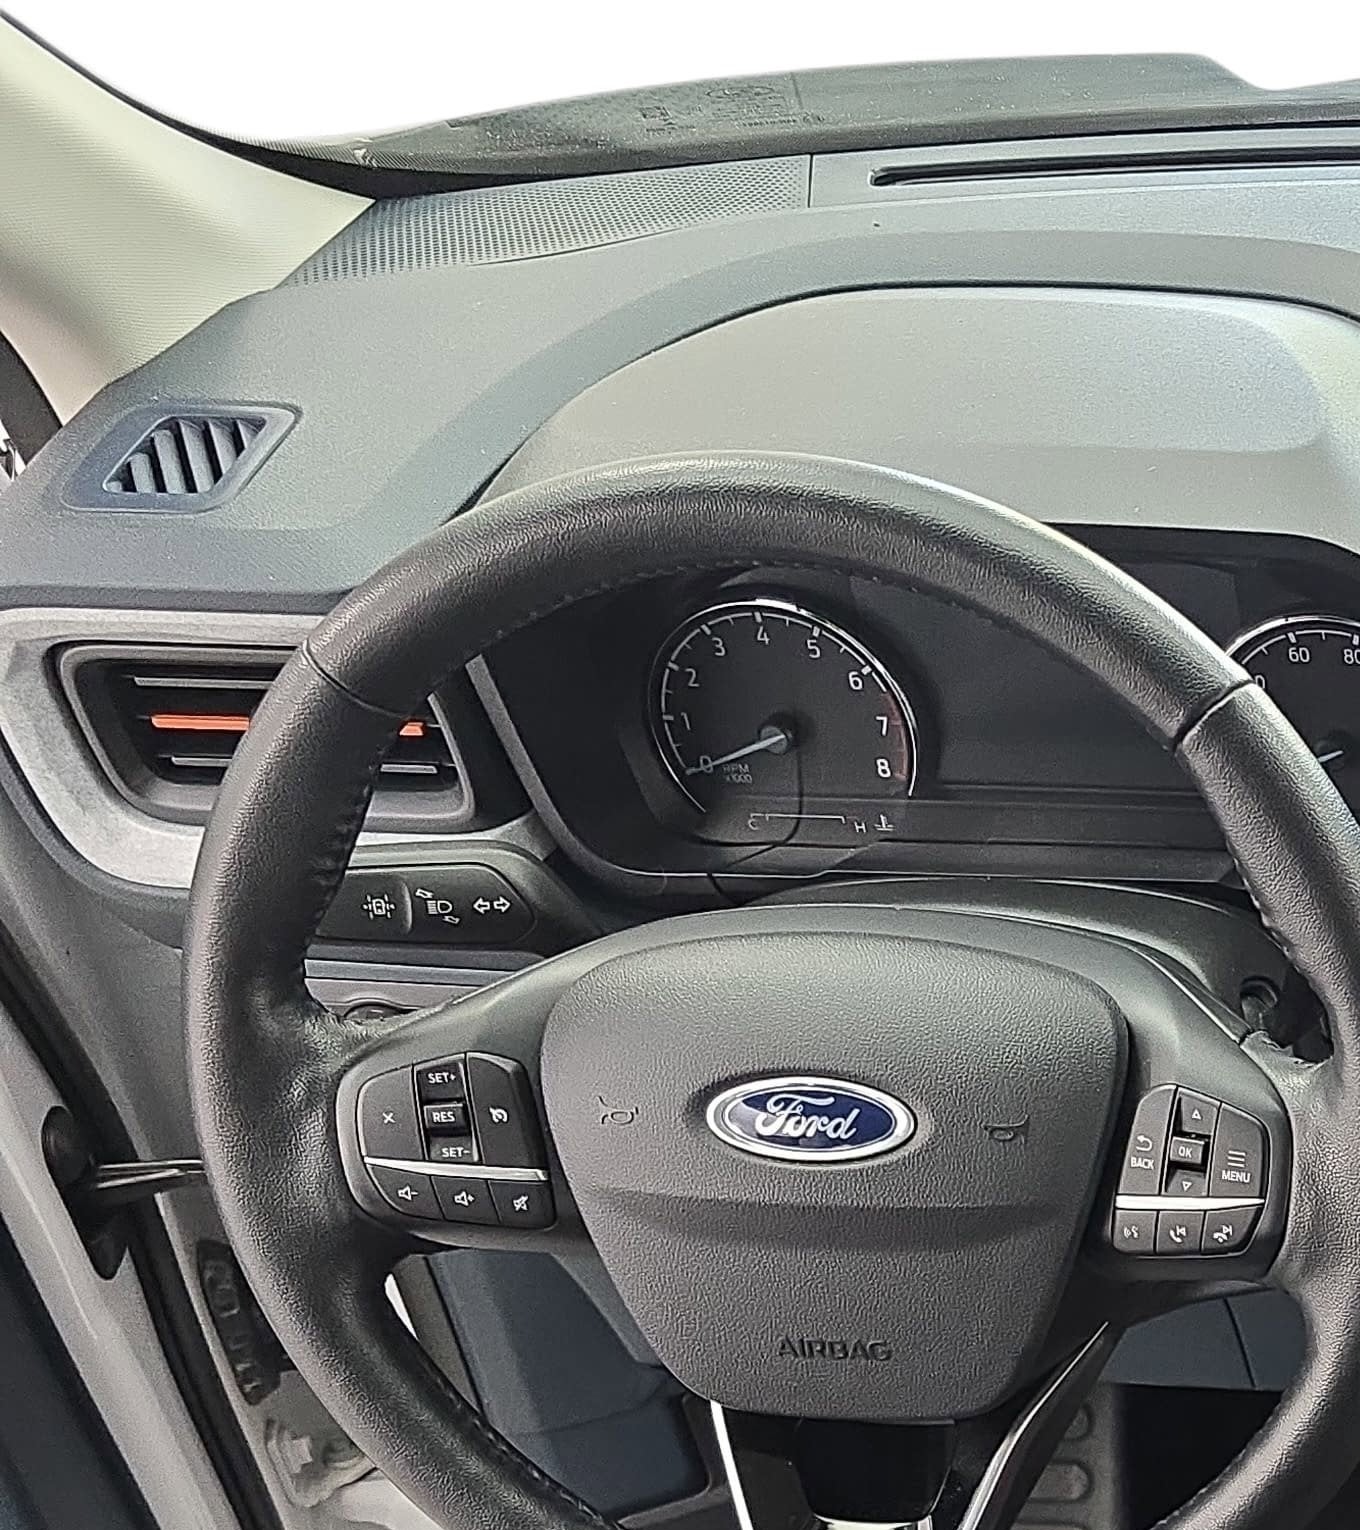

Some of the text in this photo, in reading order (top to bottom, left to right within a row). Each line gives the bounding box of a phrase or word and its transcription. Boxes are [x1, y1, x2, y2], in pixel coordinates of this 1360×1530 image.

[756, 626, 770, 645] 4
[714, 638, 726, 657] 3
[807, 639, 821, 659] 5
[1288, 647, 1310, 662] 60
[686, 668, 699, 687] 2
[848, 671, 863, 691] 6
[680, 712, 691, 730] 1
[876, 716, 889, 736] 7
[876, 758, 891, 778] 8
[855, 821, 866, 833] H
[428, 1072, 456, 1084] SET+
[432, 1112, 456, 1123] RES
[755, 1094, 861, 1139] Ford
[1178, 1146, 1192, 1158] OK
[1130, 1157, 1154, 1170] BACK
[1221, 1170, 1251, 1183] MENU
[779, 1336, 893, 1361] AIRBAG
